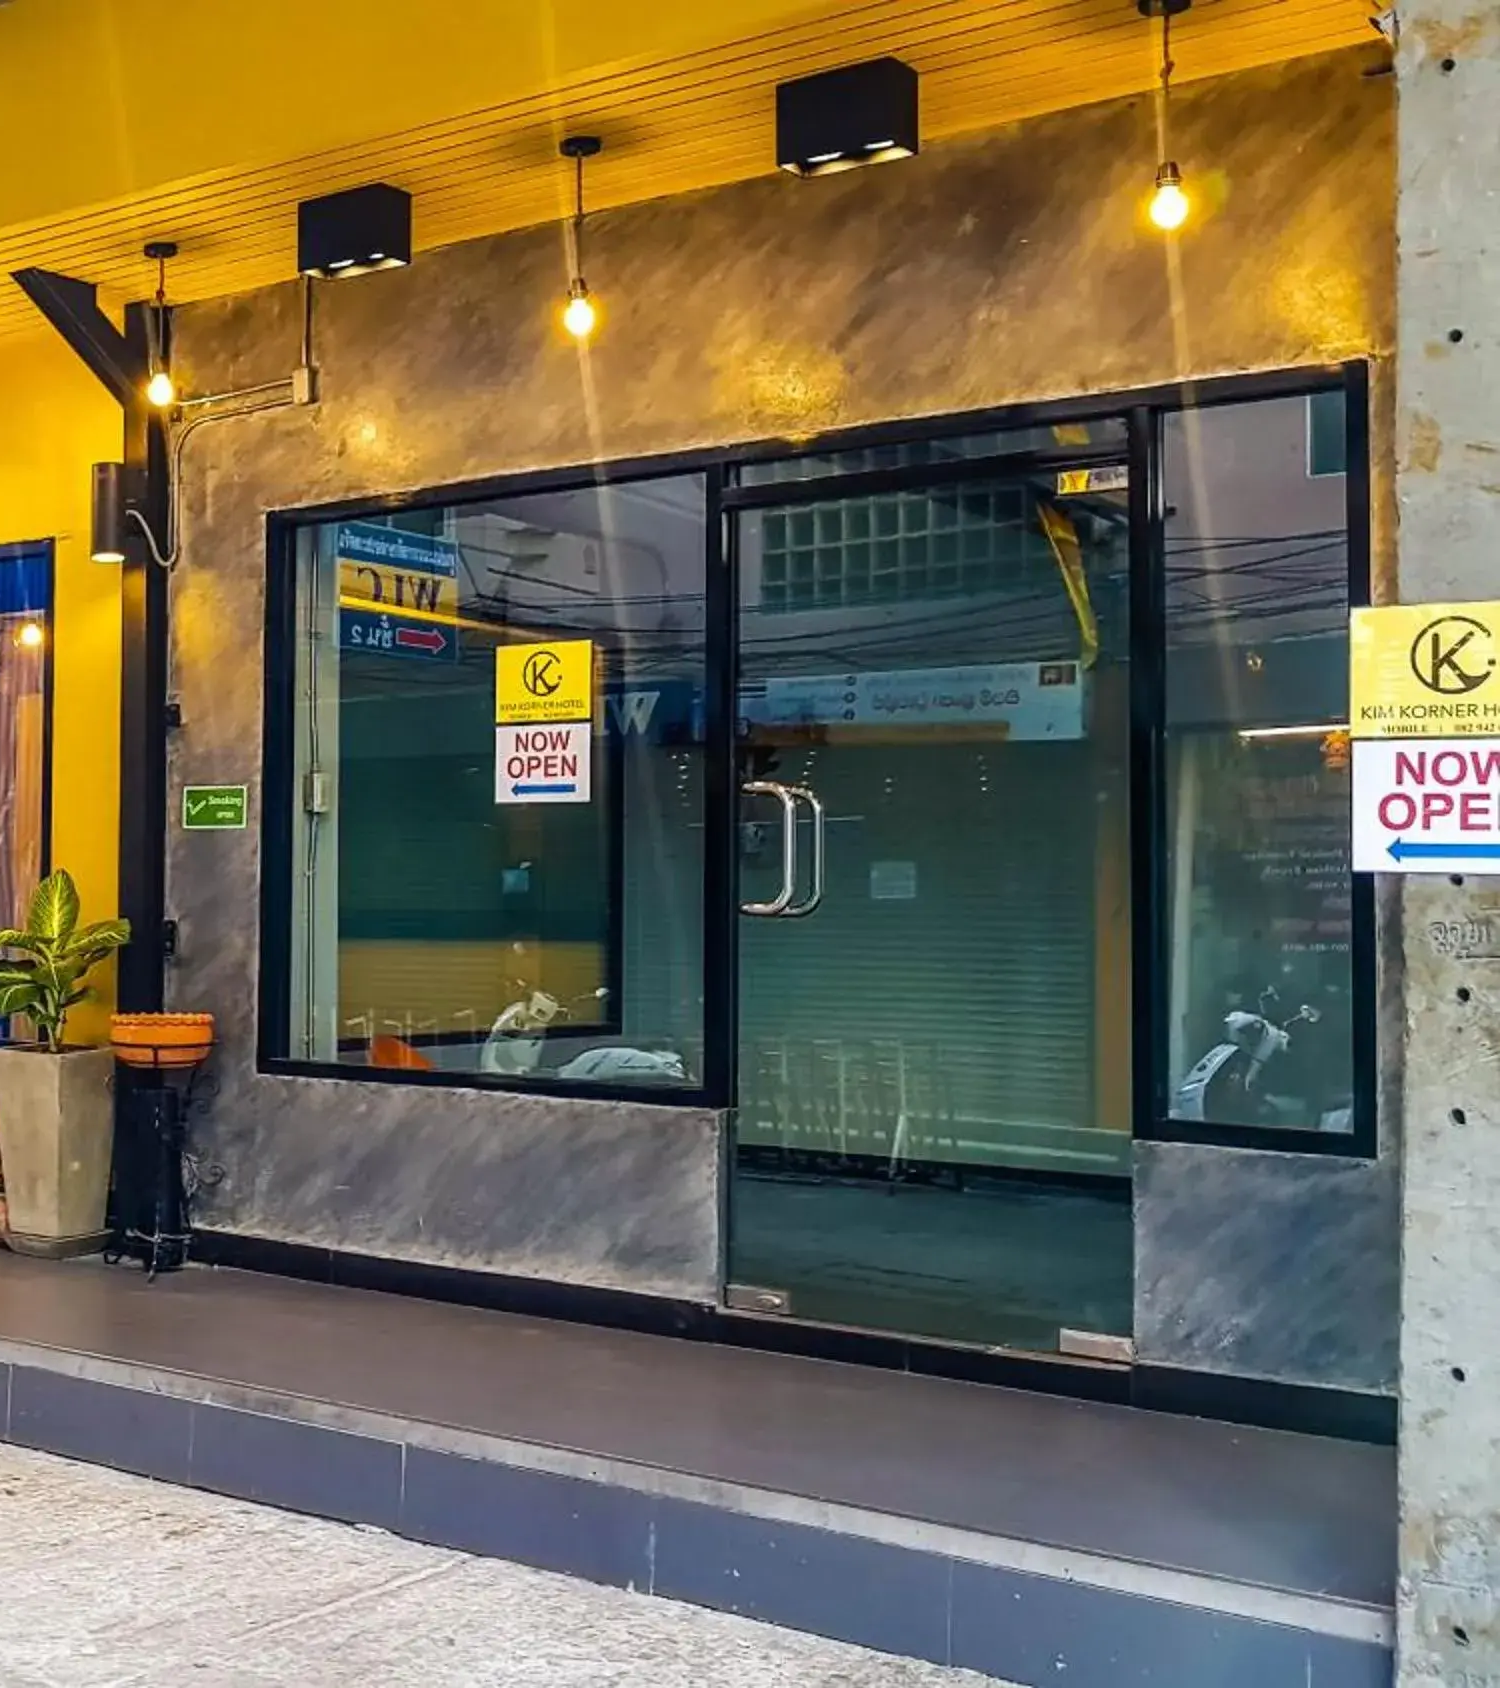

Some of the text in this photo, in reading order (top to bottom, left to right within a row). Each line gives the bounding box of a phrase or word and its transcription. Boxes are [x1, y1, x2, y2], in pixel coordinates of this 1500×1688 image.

[1360, 703, 1500, 719] KIM KORNER H
[515, 731, 570, 753] NOW
[507, 754, 577, 779] OPEN
[1378, 792, 1500, 831] OPE
